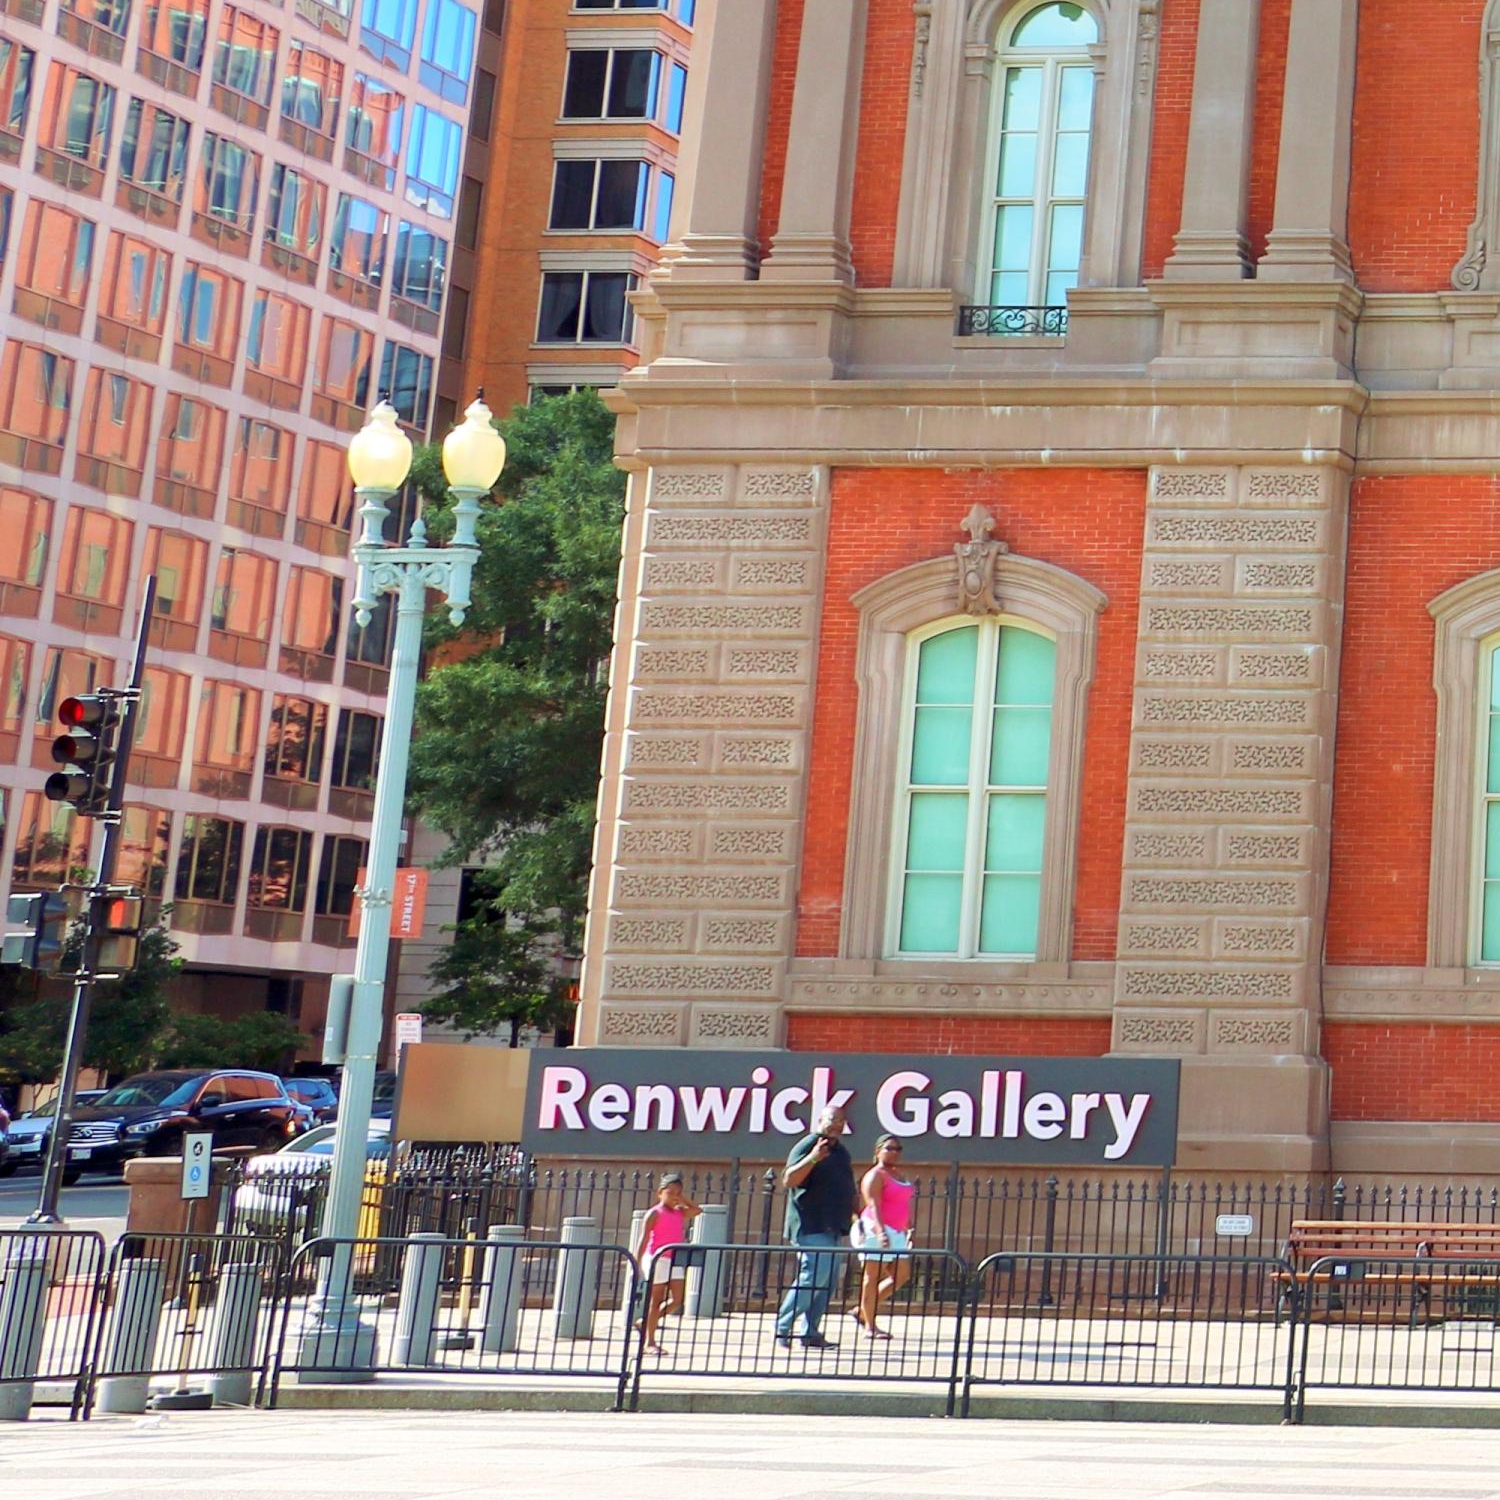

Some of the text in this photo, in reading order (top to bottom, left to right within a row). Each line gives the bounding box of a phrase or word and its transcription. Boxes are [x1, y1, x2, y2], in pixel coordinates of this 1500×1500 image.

[400, 894, 415, 933] STREET
[539, 1066, 1151, 1161] Renwick Gallery
